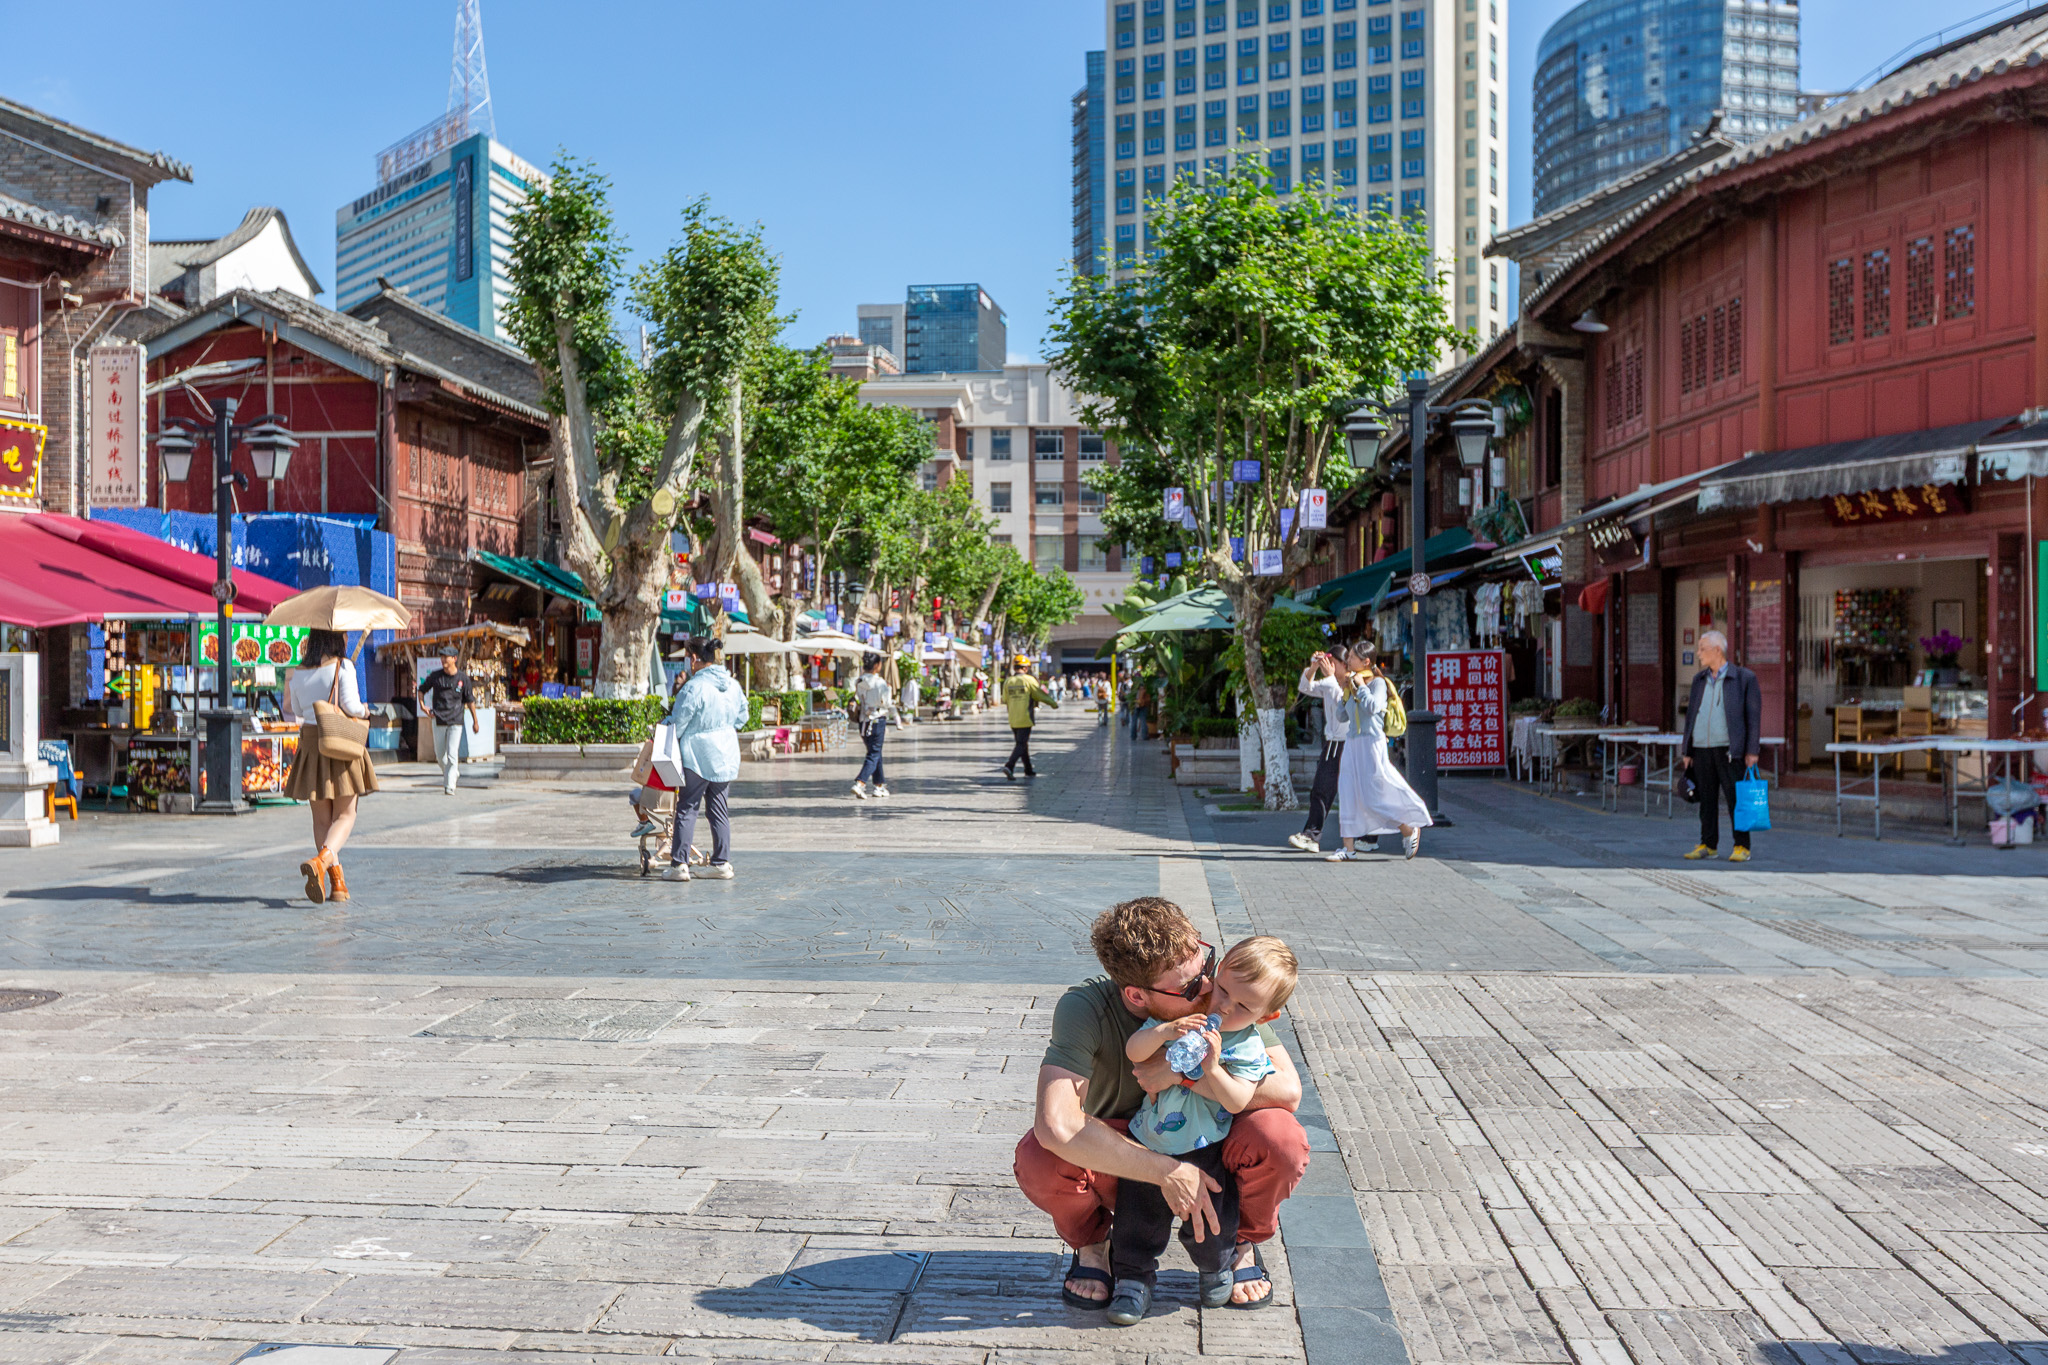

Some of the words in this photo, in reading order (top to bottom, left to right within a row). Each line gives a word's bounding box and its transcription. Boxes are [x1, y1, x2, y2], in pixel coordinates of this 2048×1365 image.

[106, 371, 124, 482] 云南过桥米线
[1467, 655, 1498, 670] 高价
[1431, 657, 1461, 685] 押
[1467, 671, 1498, 685] 回收
[1432, 688, 1453, 702] 翡翠
[1455, 688, 1475, 701] 南红
[1477, 687, 1499, 701] 绿松
[1433, 703, 1463, 717] 蜜蜡
[1468, 702, 1499, 716] 文玩
[1435, 717, 1464, 732] 名表
[1468, 717, 1499, 731] 名包
[1436, 733, 1499, 749] 黄金钻石
